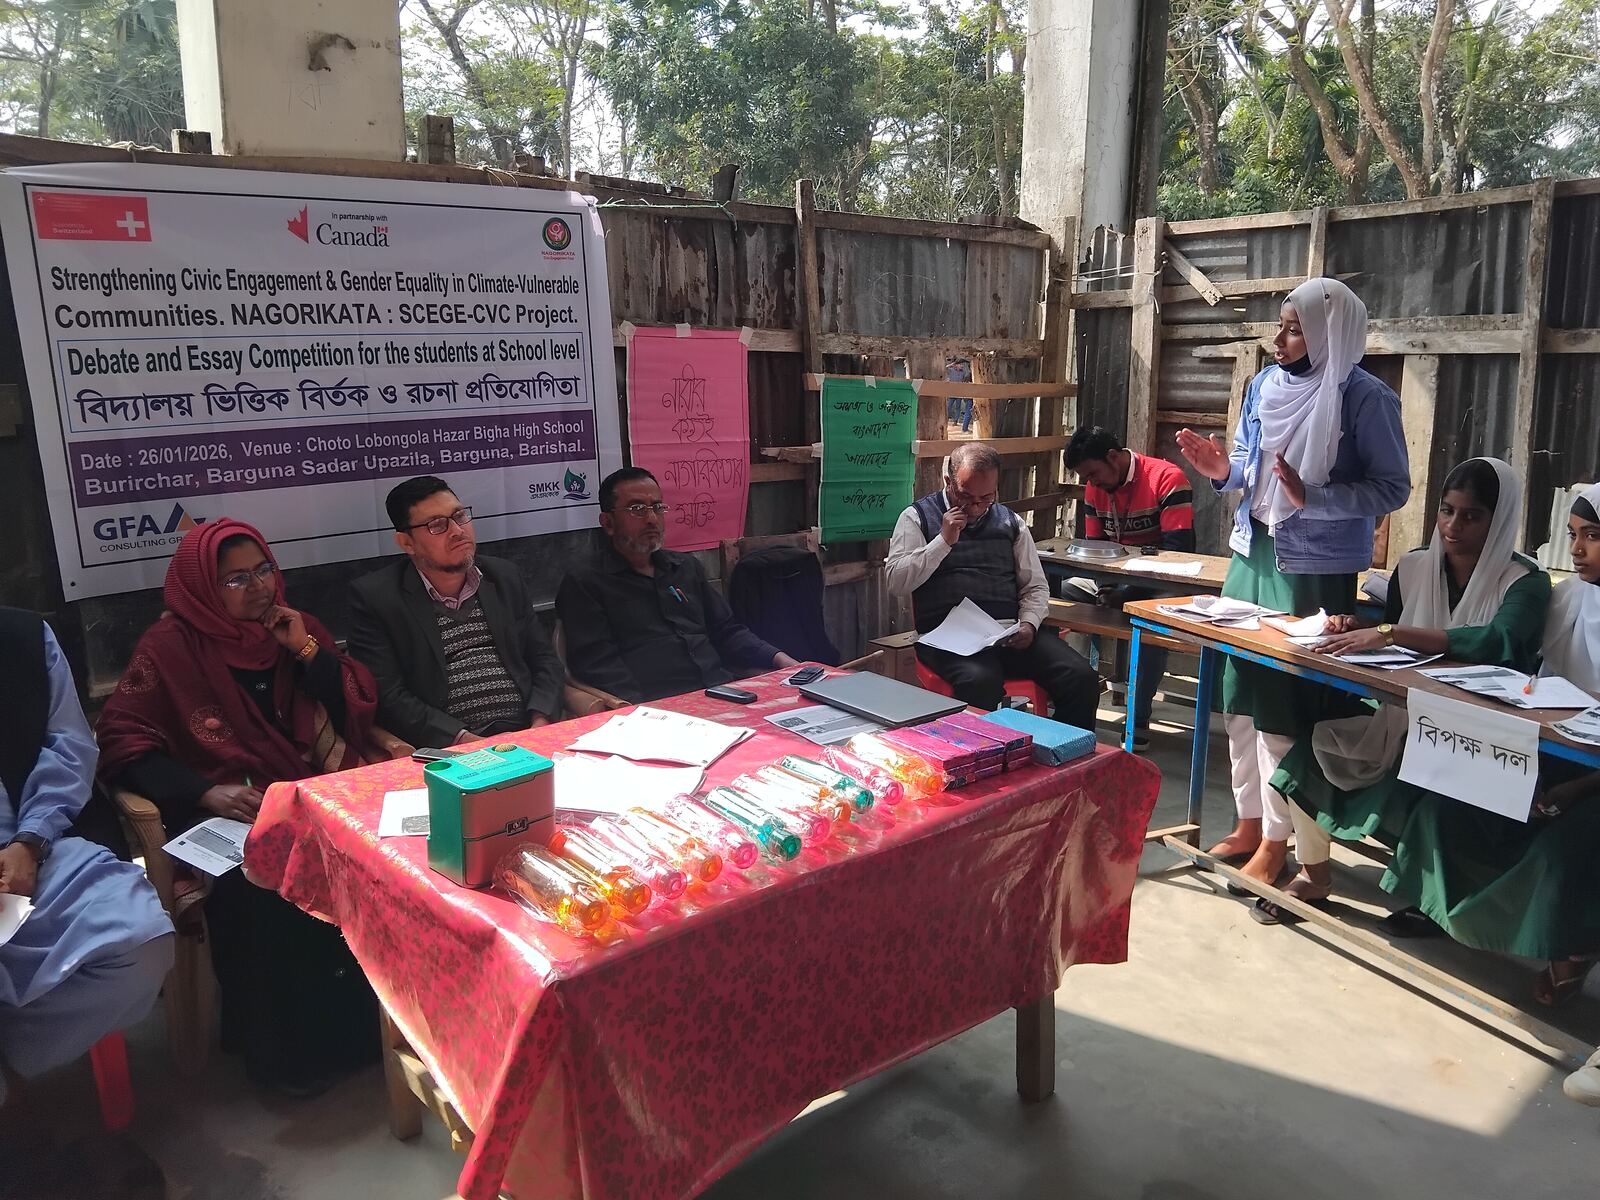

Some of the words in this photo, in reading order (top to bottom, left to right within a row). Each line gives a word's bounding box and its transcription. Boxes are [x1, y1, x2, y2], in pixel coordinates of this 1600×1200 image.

[339, 213, 374, 222] partnership
[376, 214, 388, 222] with
[316, 223, 390, 247] Canada
[51, 266, 177, 296] Strengthening
[181, 268, 222, 291] Civic
[226, 268, 323, 296] Engagement
[326, 270, 338, 291] &
[340, 270, 391, 291] Gender
[395, 271, 449, 297] Equality
[452, 273, 465, 293] in
[468, 272, 580, 294] Climate-Vulnerable
[55, 304, 225, 328] Communities.
[231, 303, 382, 325] NAGORIKATA
[387, 308, 393, 323] :
[399, 303, 511, 324] SCEGE-CVC
[516, 304, 578, 328] Project.
[67, 347, 140, 375] Debate
[146, 346, 182, 373] and
[187, 345, 243, 375] Essay
[249, 342, 354, 373] Competition
[358, 341, 381, 365] for
[385, 340, 410, 364] the
[414, 340, 478, 363] students
[482, 343, 496, 362] at
[499, 339, 547, 361] School
[550, 338, 580, 360] level
[73, 388, 195, 423] বিদ্যালয়
[200, 381, 291, 416] ভিত্তিক
[377, 384, 398, 404] ও
[403, 379, 459, 404] রচনা
[466, 371, 581, 403] প্রতিযোগিতা
[80, 452, 122, 470] Date
[138, 443, 233, 466] 26/01/2026,
[241, 441, 292, 457] Venue
[306, 434, 351, 452] Choto
[355, 430, 430, 449] Lobongola
[433, 428, 470, 443] Hazar
[474, 424, 511, 441] Bigha
[513, 421, 540, 439] High
[543, 419, 584, 434] School
[85, 472, 200, 496] Burirchar,
[206, 462, 296, 484] Barguna
[302, 456, 358, 476] Sadar
[364, 450, 435, 471] Upazila,
[440, 446, 514, 465] Barguna,
[519, 440, 585, 456] Barishal.
[529, 481, 560, 493] SMKK
[93, 514, 161, 540] GFA
[100, 538, 166, 552] CONSULTING
[1416, 715, 1483, 759] বিপক্ষ
[1490, 743, 1531, 776] দল
